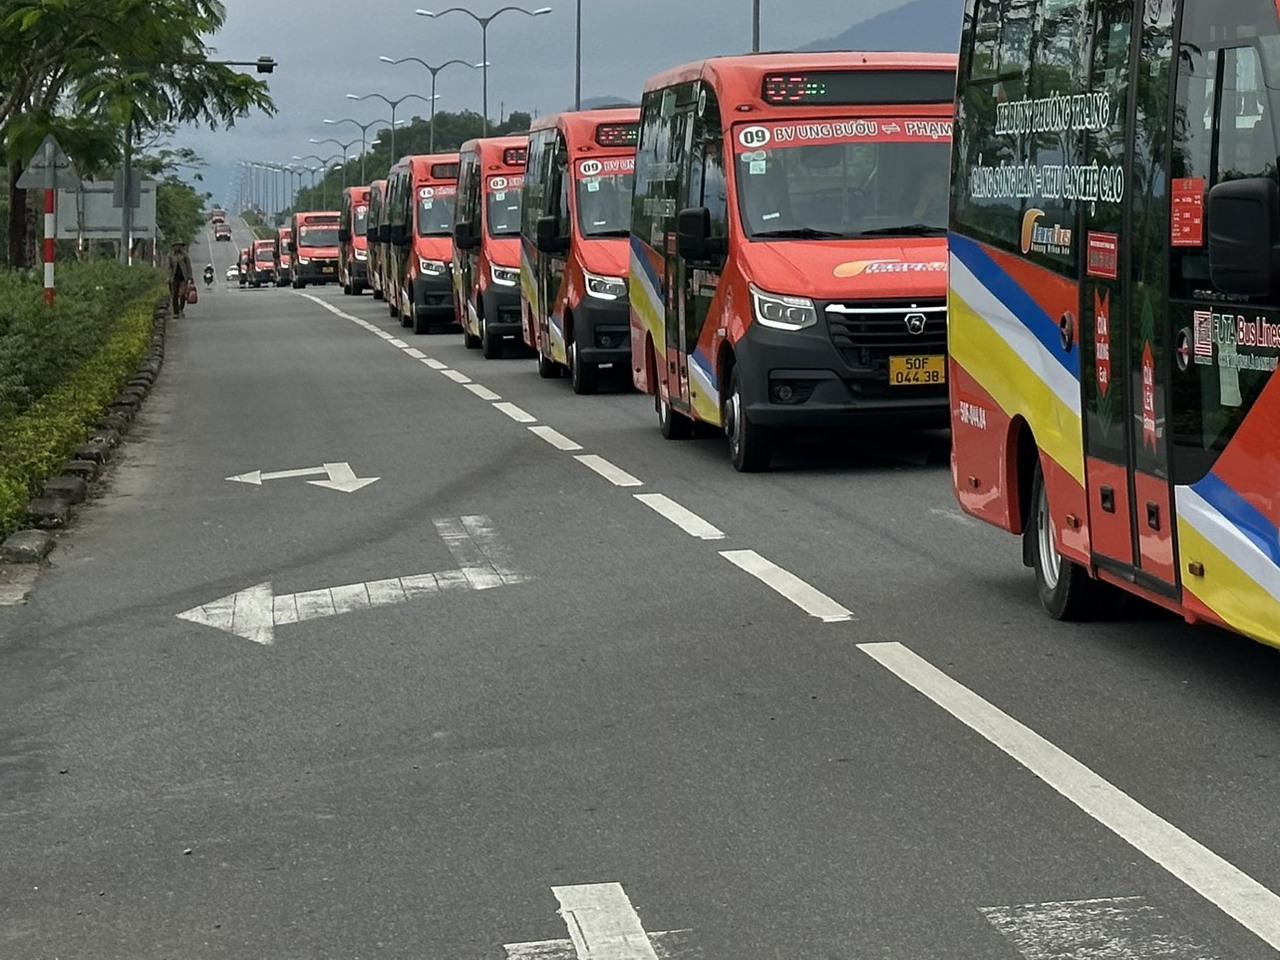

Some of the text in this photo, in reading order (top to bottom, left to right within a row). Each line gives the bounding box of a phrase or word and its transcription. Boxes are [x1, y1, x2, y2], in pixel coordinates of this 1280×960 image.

[743, 129, 767, 144] 09
[773, 126, 796, 142] BV
[798, 124, 832, 139] UNG
[583, 163, 599, 173] 09
[1100, 166, 1125, 203] CAO
[1212, 313, 1237, 344] FUTA
[1237, 315, 1256, 347] Bus
[906, 357, 929, 370] 50F
[896, 370, 939, 384] 044.38
